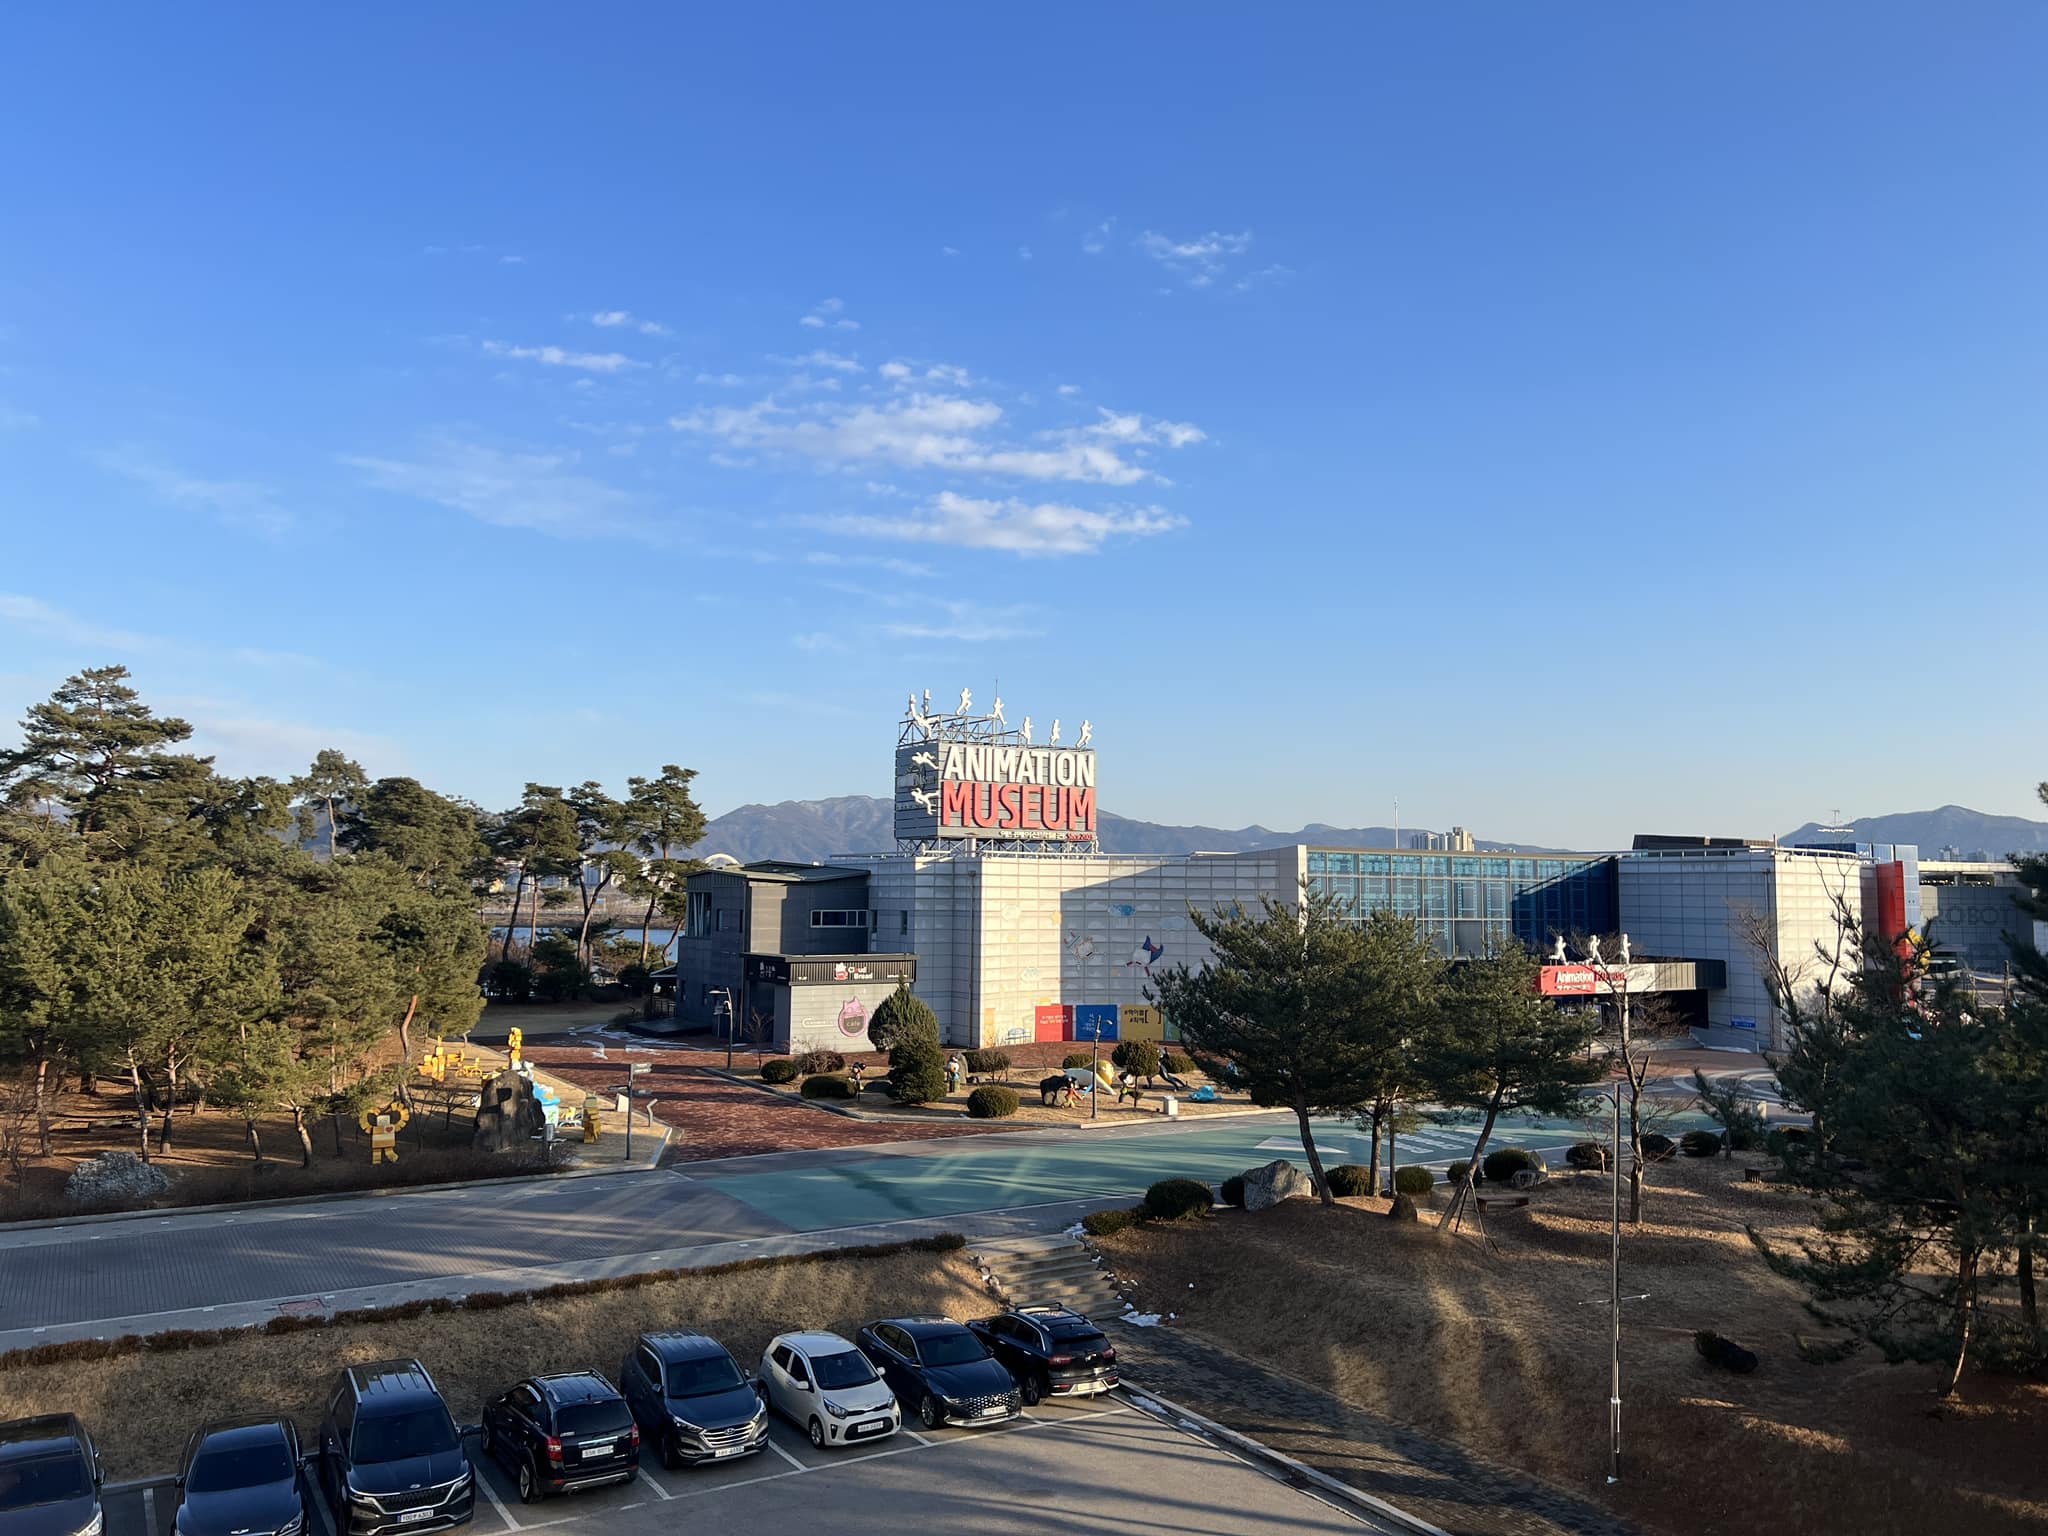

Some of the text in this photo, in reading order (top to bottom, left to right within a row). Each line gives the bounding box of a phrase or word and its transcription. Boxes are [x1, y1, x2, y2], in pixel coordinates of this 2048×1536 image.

[943, 746, 1095, 787] ANIMATION
[941, 781, 1096, 831] MUSEUM
[1555, 970, 1595, 984] Animation
